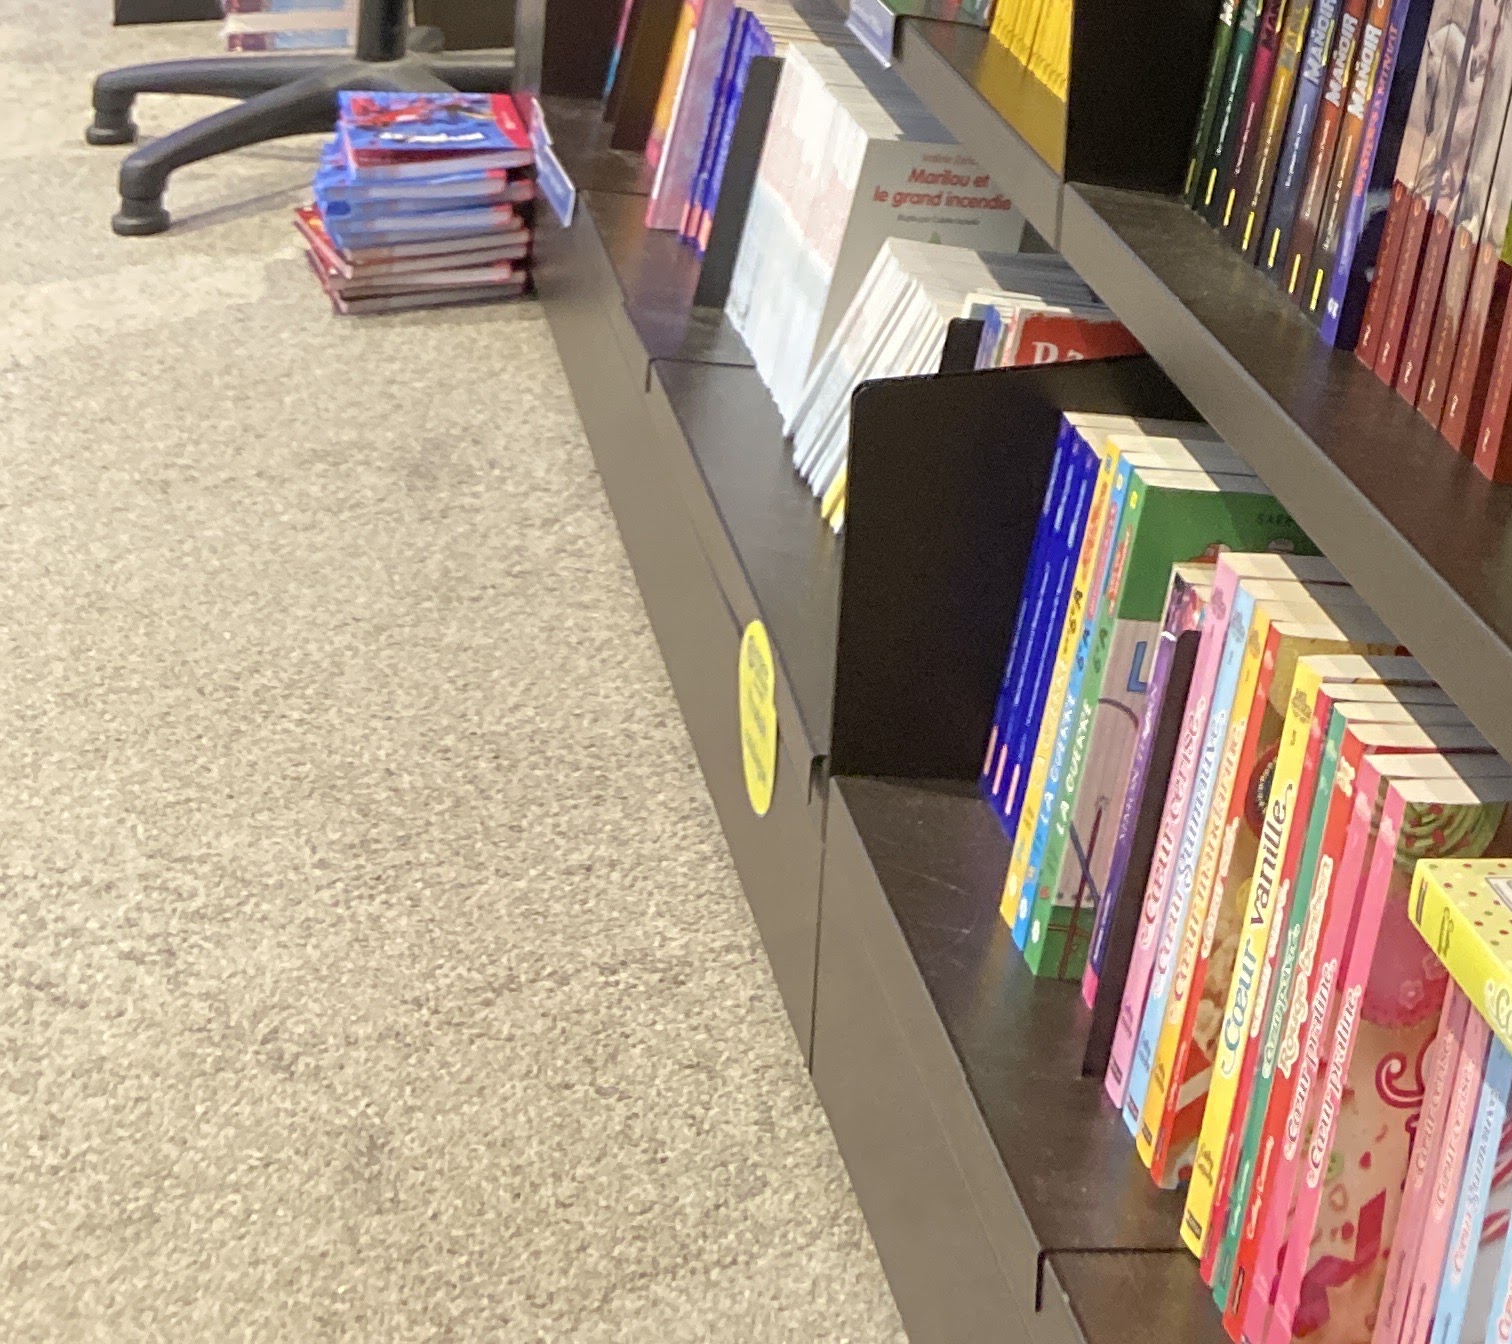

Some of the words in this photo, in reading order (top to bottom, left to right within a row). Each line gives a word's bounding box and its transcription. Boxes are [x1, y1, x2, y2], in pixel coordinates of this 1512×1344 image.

[908, 168, 970, 187] Marilou
[973, 174, 990, 188] et
[872, 185, 888, 203] le
[891, 191, 943, 208] grand
[946, 192, 1012, 211] incendie
[1251, 789, 1292, 926] vanille
